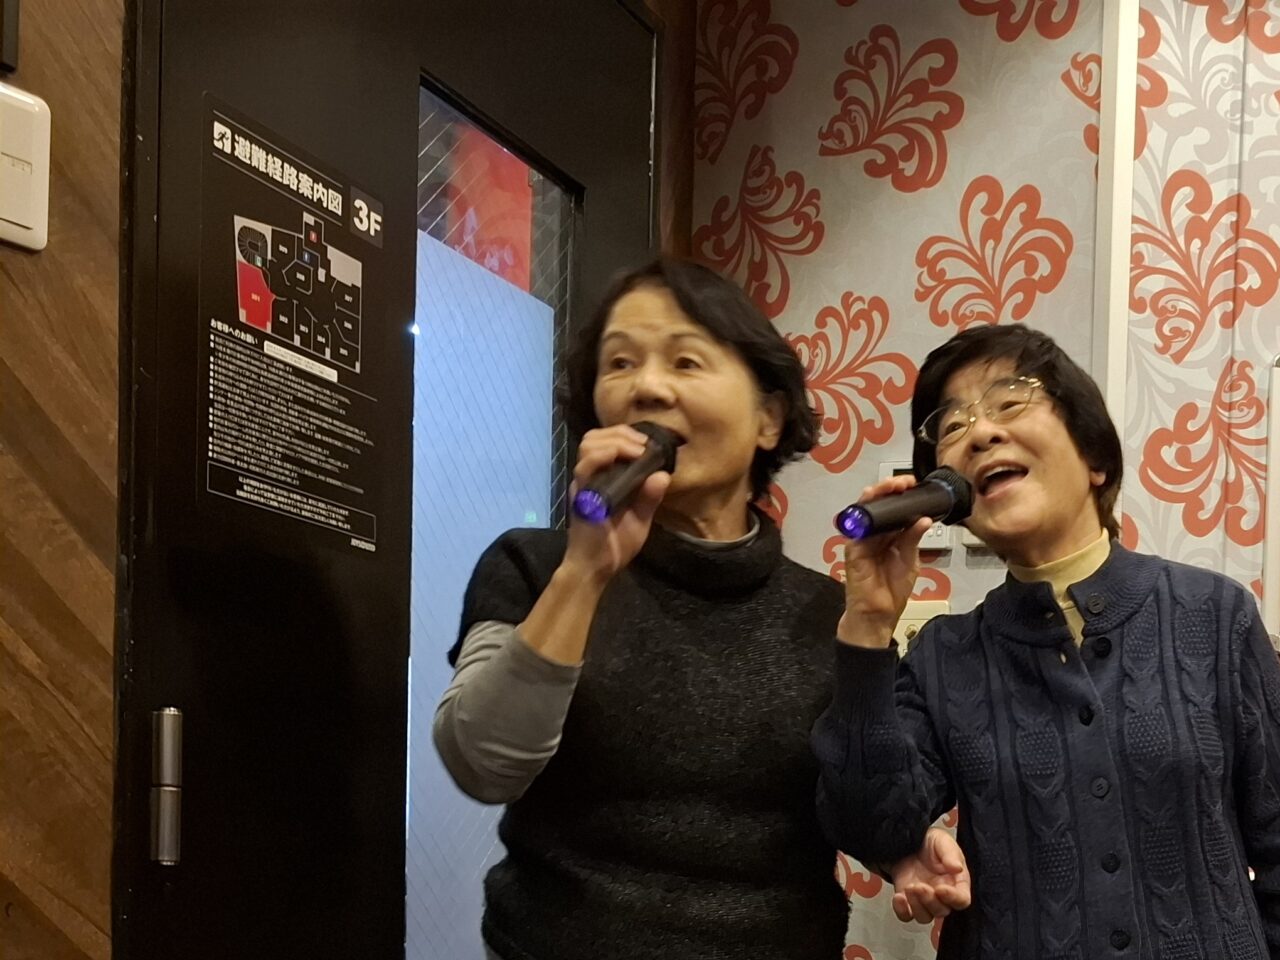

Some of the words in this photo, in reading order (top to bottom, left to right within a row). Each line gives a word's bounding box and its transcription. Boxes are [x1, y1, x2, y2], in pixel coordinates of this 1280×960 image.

[234, 133, 342, 217] 避難経路案内図
[353, 198, 382, 237] 3F
